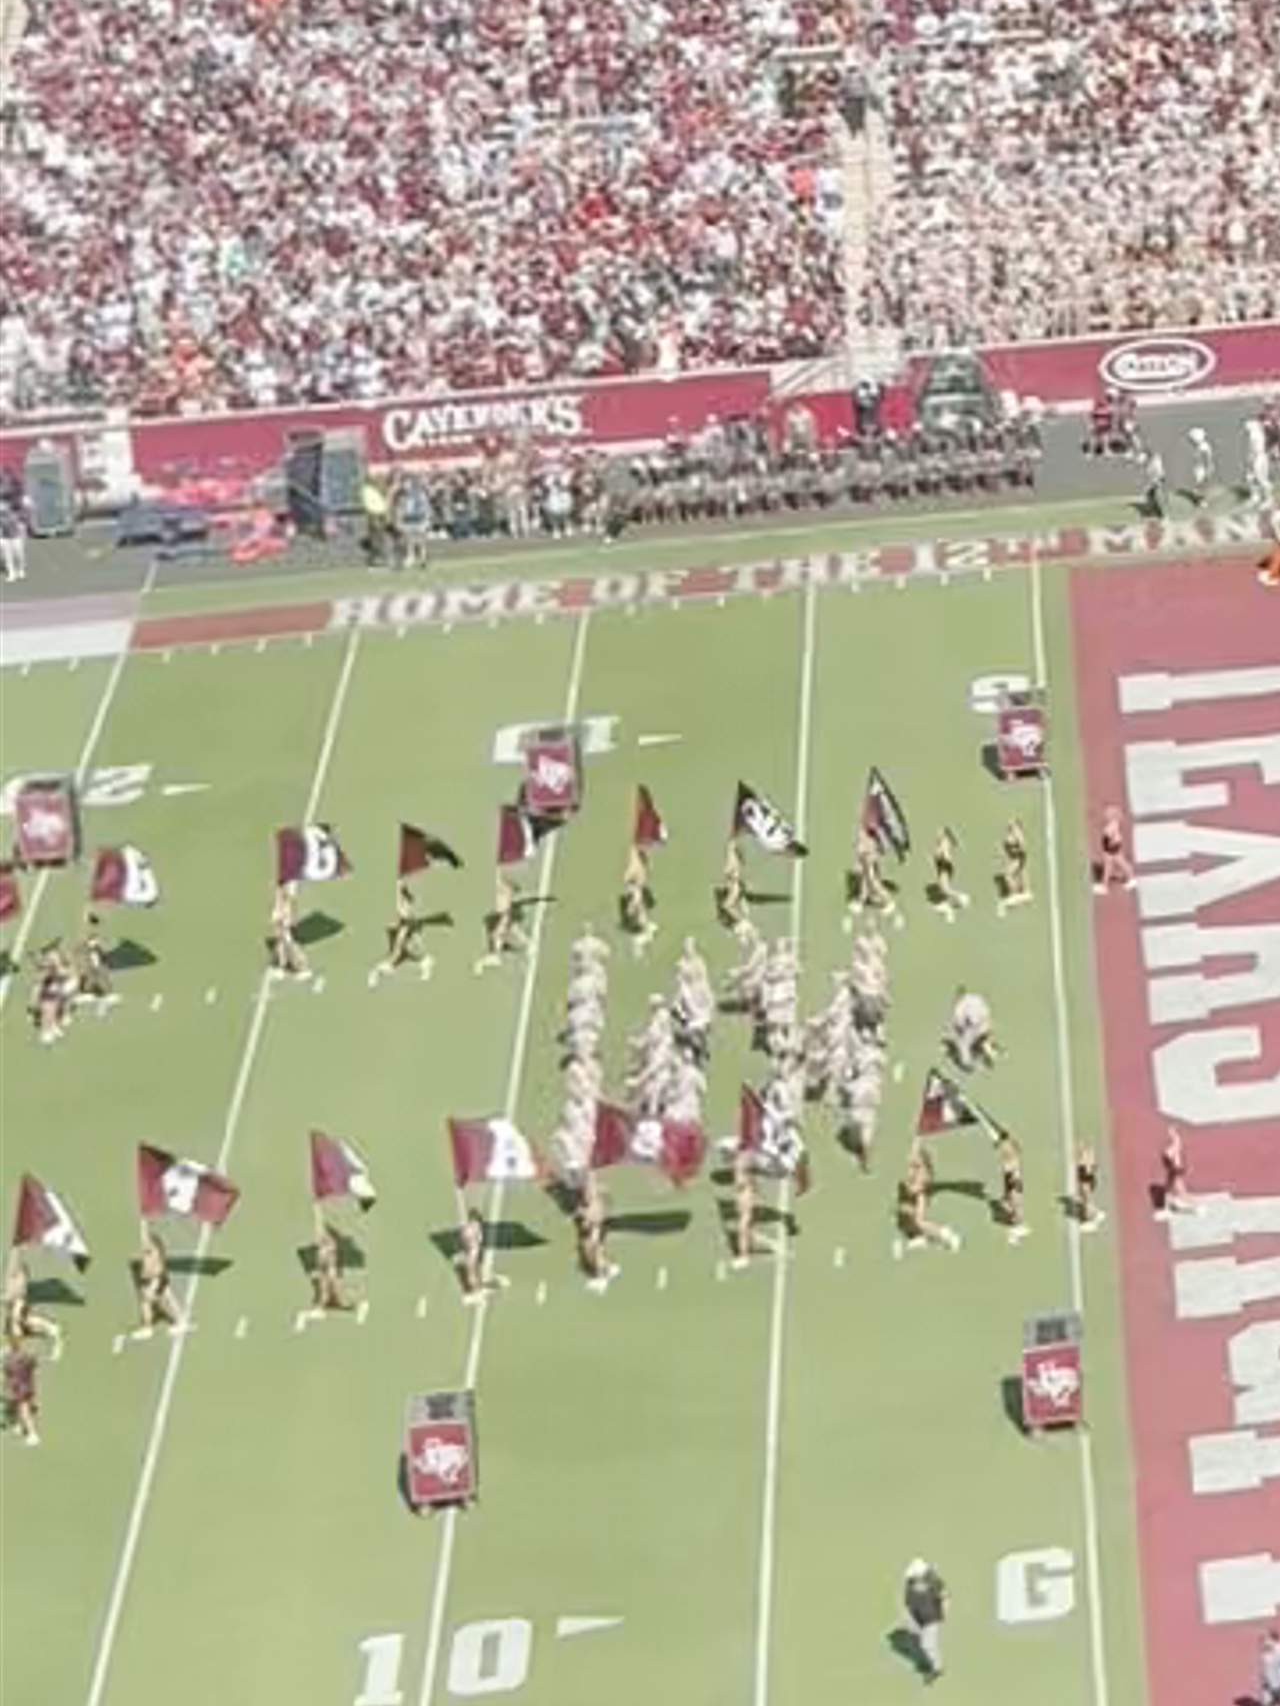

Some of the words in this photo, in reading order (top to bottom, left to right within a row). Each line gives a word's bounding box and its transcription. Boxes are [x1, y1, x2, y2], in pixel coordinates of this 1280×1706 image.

[331, 580, 562, 629] HOME
[591, 571, 692, 603] OF
[729, 548, 880, 592] THE
[1090, 514, 1264, 557] MAN
[996, 1545, 1076, 1624] G
